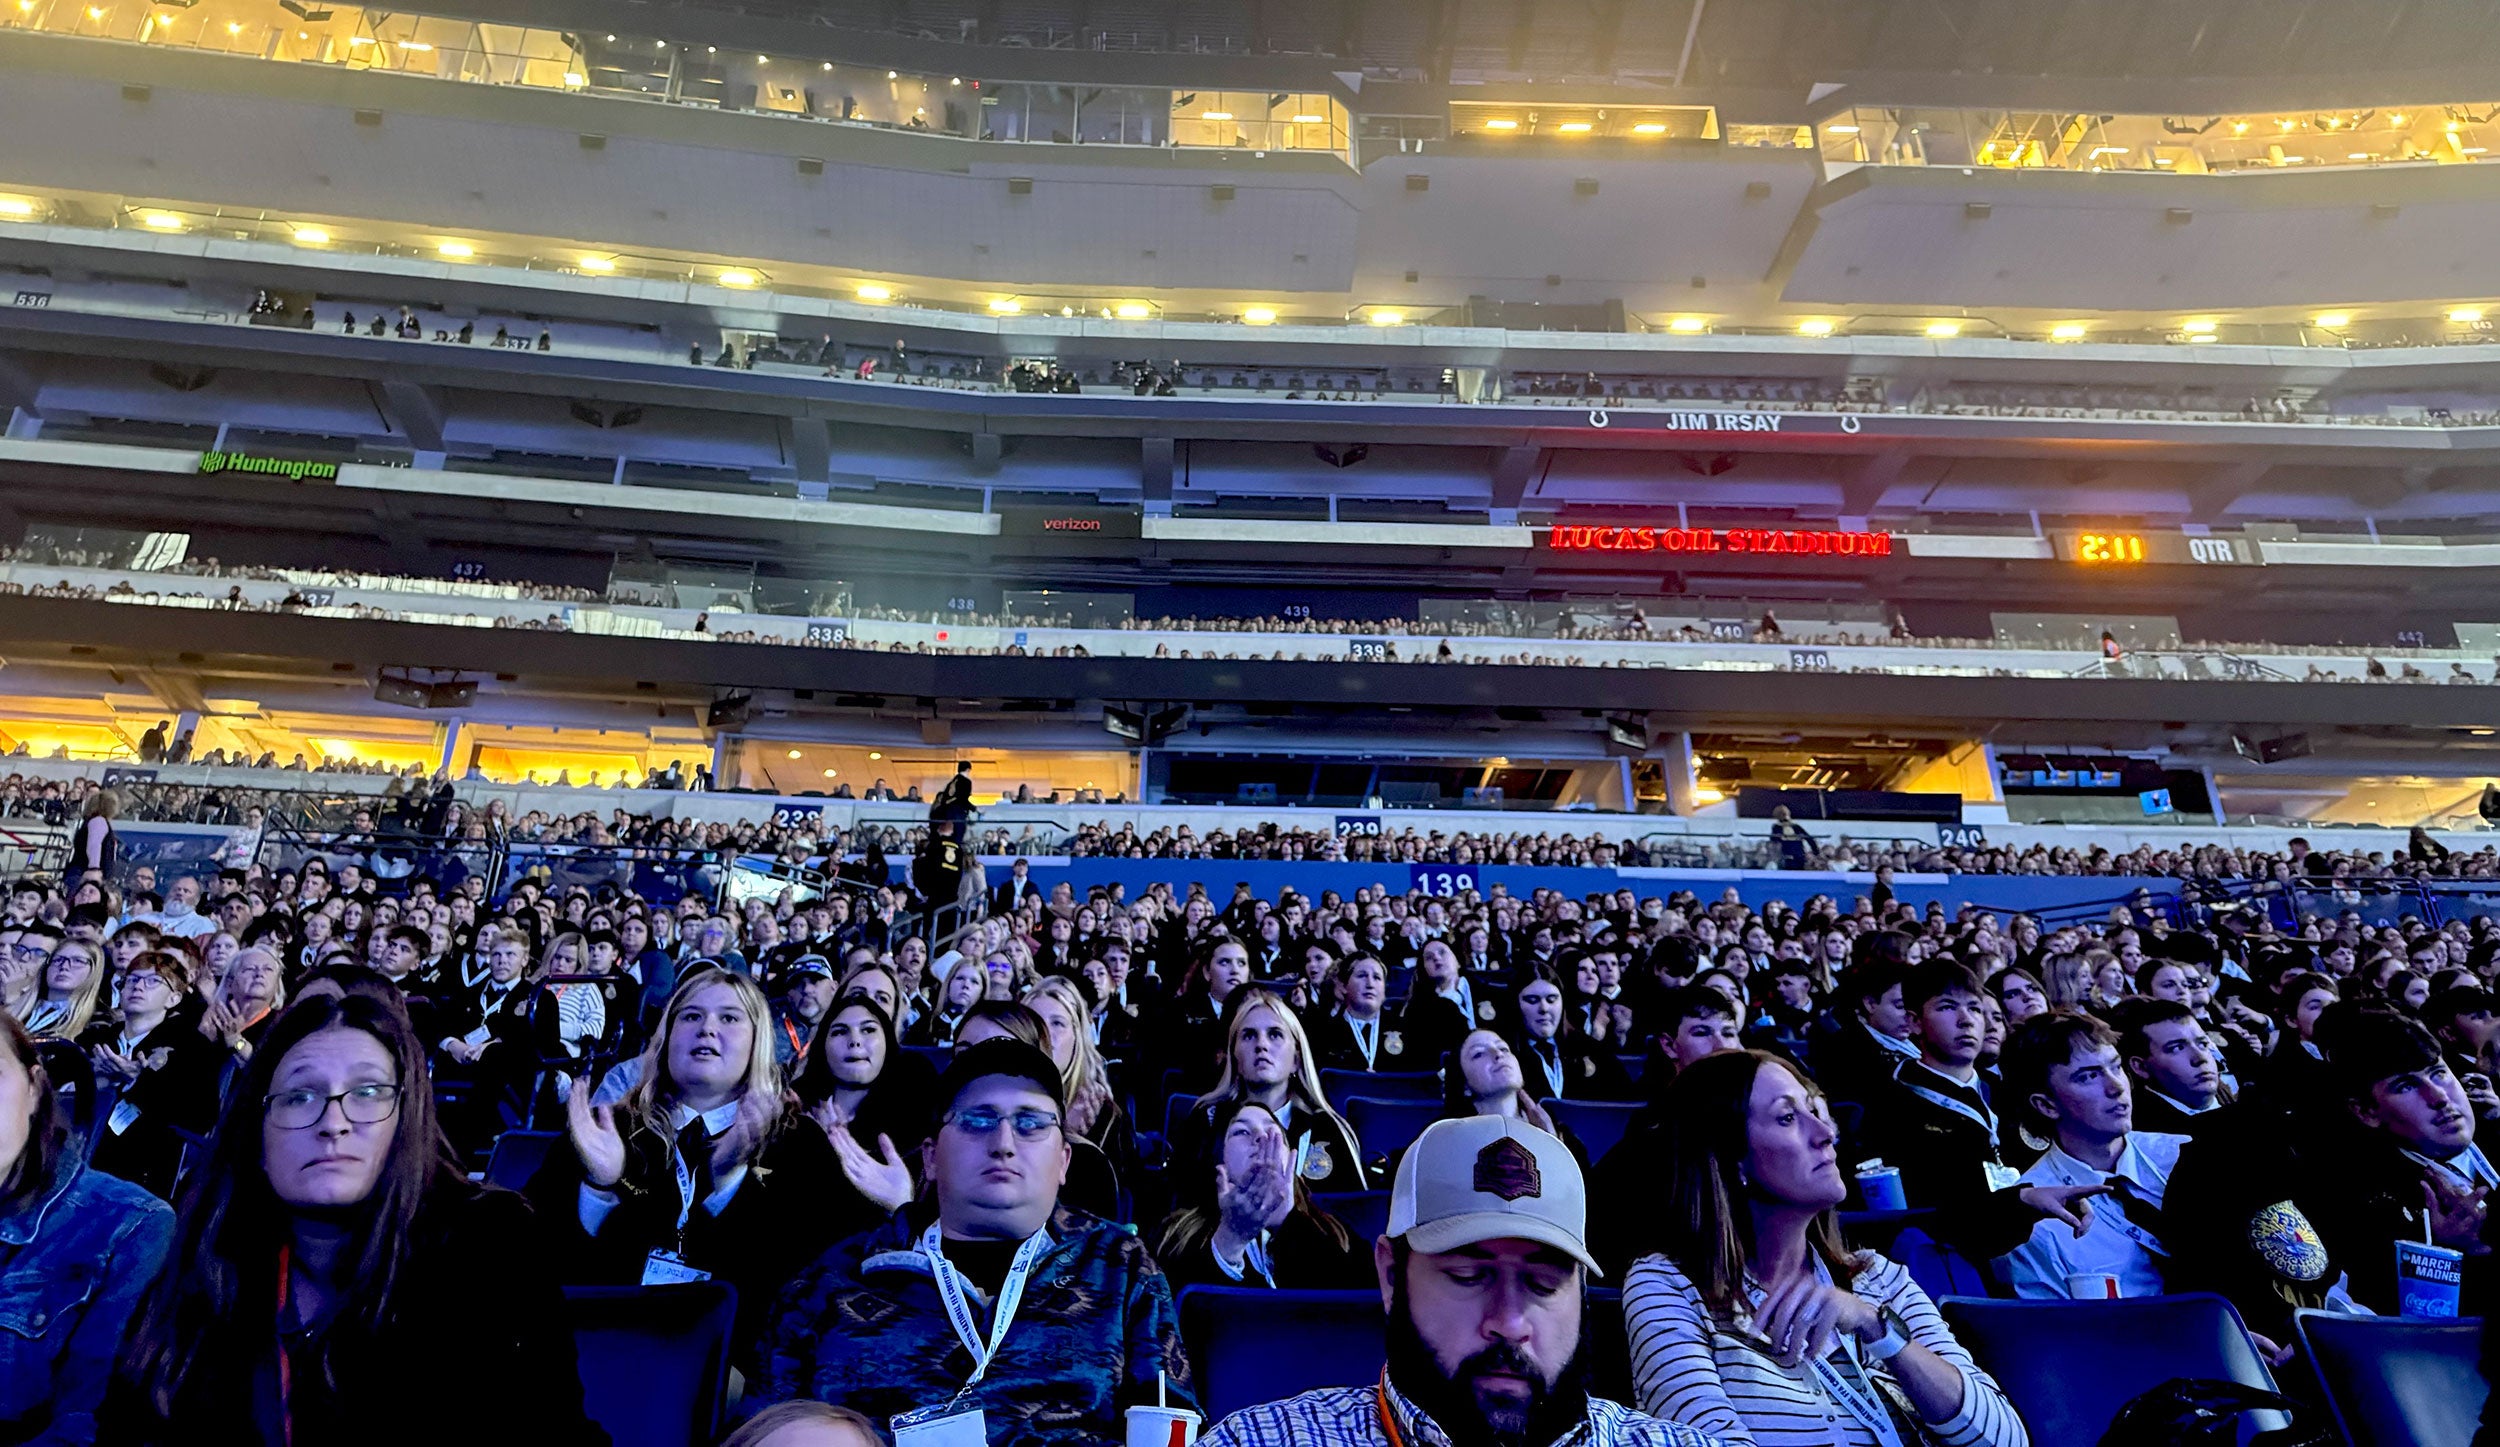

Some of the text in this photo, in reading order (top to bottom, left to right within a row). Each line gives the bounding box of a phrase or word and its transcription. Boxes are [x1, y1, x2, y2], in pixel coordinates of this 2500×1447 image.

[17, 294, 48, 307] 536
[1667, 412, 1782, 432] JIM IRSAY
[226, 452, 336, 480] Huntington
[1043, 517, 1100, 530] verizon
[1550, 524, 1892, 556] LUCAS OIL STADIUM
[2080, 534, 2143, 561] 2:11
[2188, 538, 2235, 564] QTR
[453, 562, 483, 576] 437
[949, 597, 975, 611] 438
[1284, 605, 1310, 617] 439
[809, 626, 845, 643] 338
[1352, 643, 1385, 657] 339
[1793, 653, 1828, 668] 340
[1339, 821, 1379, 836] 239
[1941, 829, 1982, 848] 240
[1418, 872, 1474, 898] 139
[2410, 1253, 2452, 1271] MARCH
[2415, 1265, 2462, 1284] MADNESS
